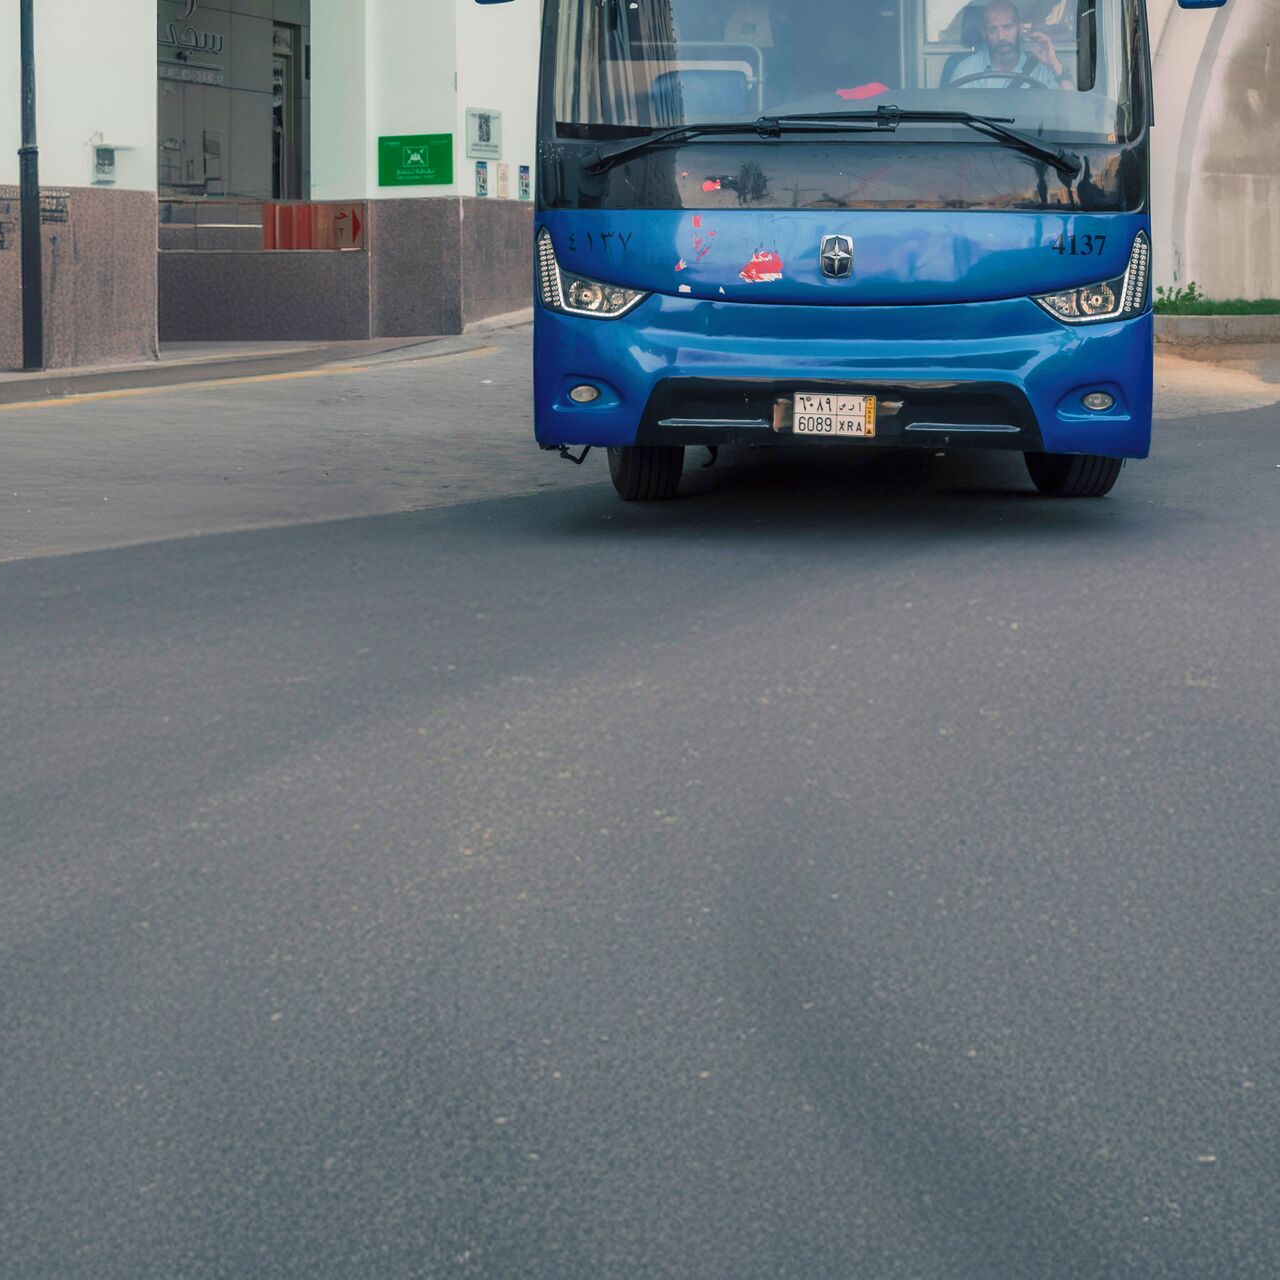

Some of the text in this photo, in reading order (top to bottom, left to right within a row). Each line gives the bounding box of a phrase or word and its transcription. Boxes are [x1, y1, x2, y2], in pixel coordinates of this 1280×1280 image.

[568, 231, 632, 253] ٤١٣٧
[1051, 232, 1107, 256] 4137
[799, 396, 832, 413] ٦٠٨٩
[798, 416, 863, 432] 6089 XRA
